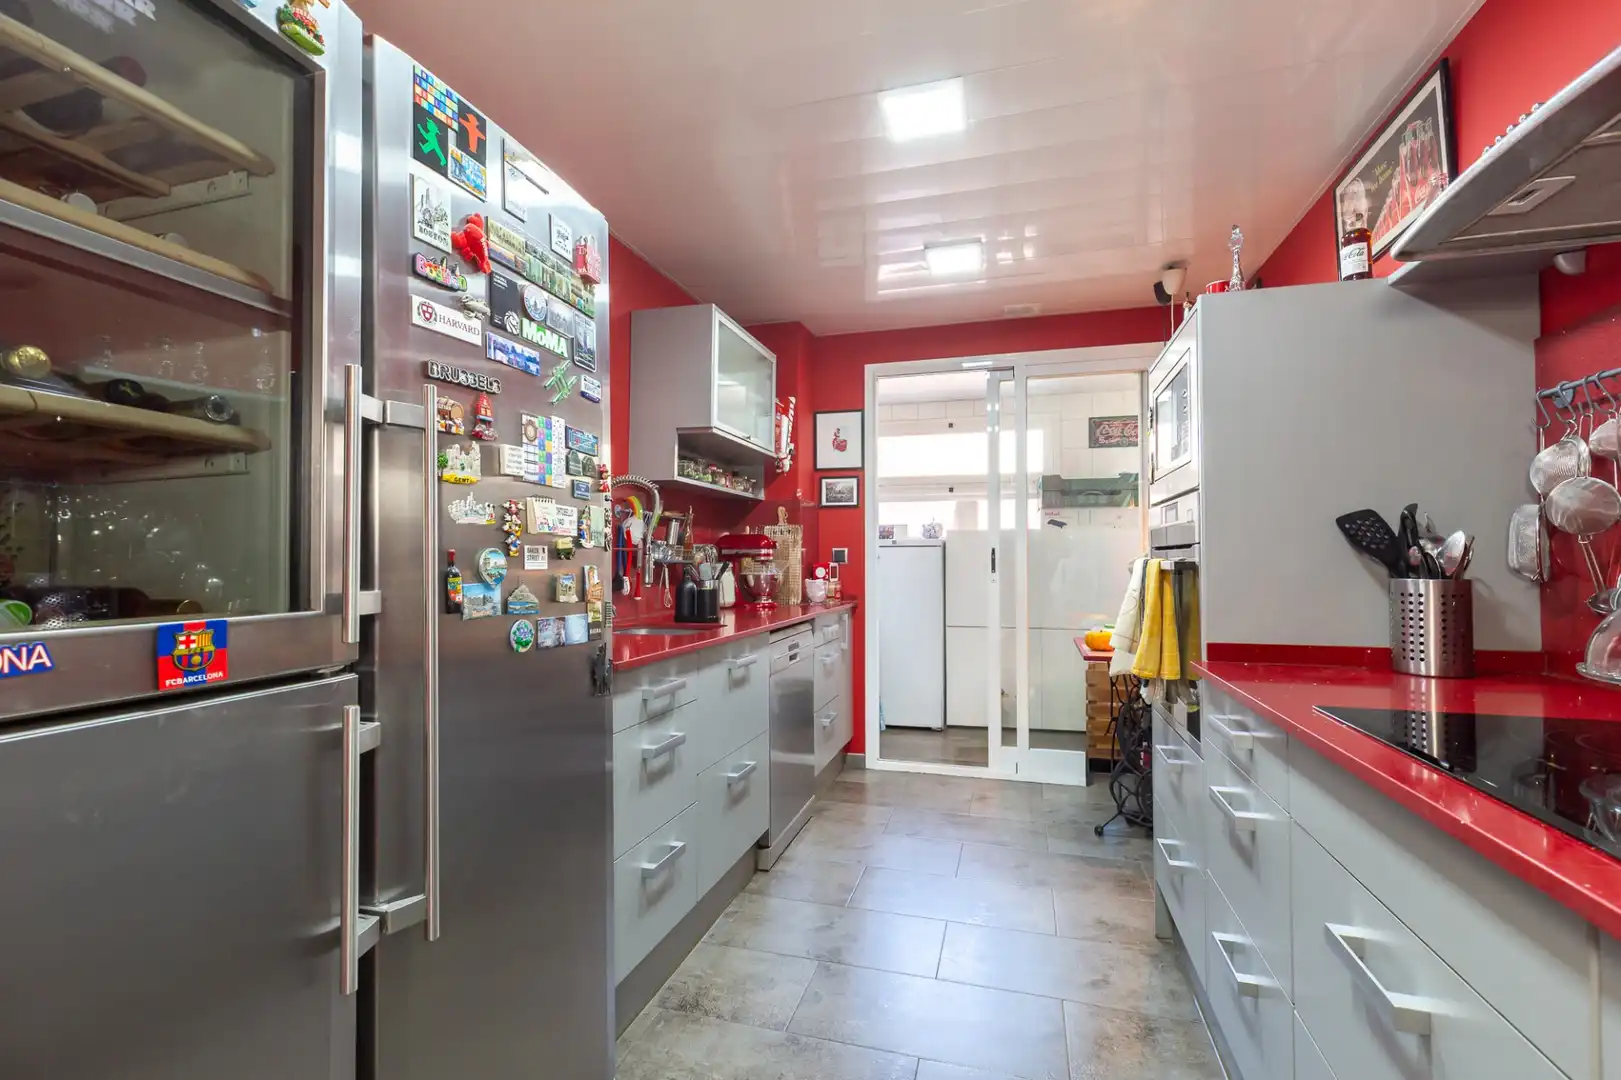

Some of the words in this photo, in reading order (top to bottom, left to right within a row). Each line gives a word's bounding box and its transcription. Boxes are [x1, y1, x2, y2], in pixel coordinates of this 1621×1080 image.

[439, 314, 480, 336] HARVARD
[428, 360, 501, 393] BRUSSELS
[0, 645, 52, 674] NA
[165, 671, 223, 687] FCBARCELONA
